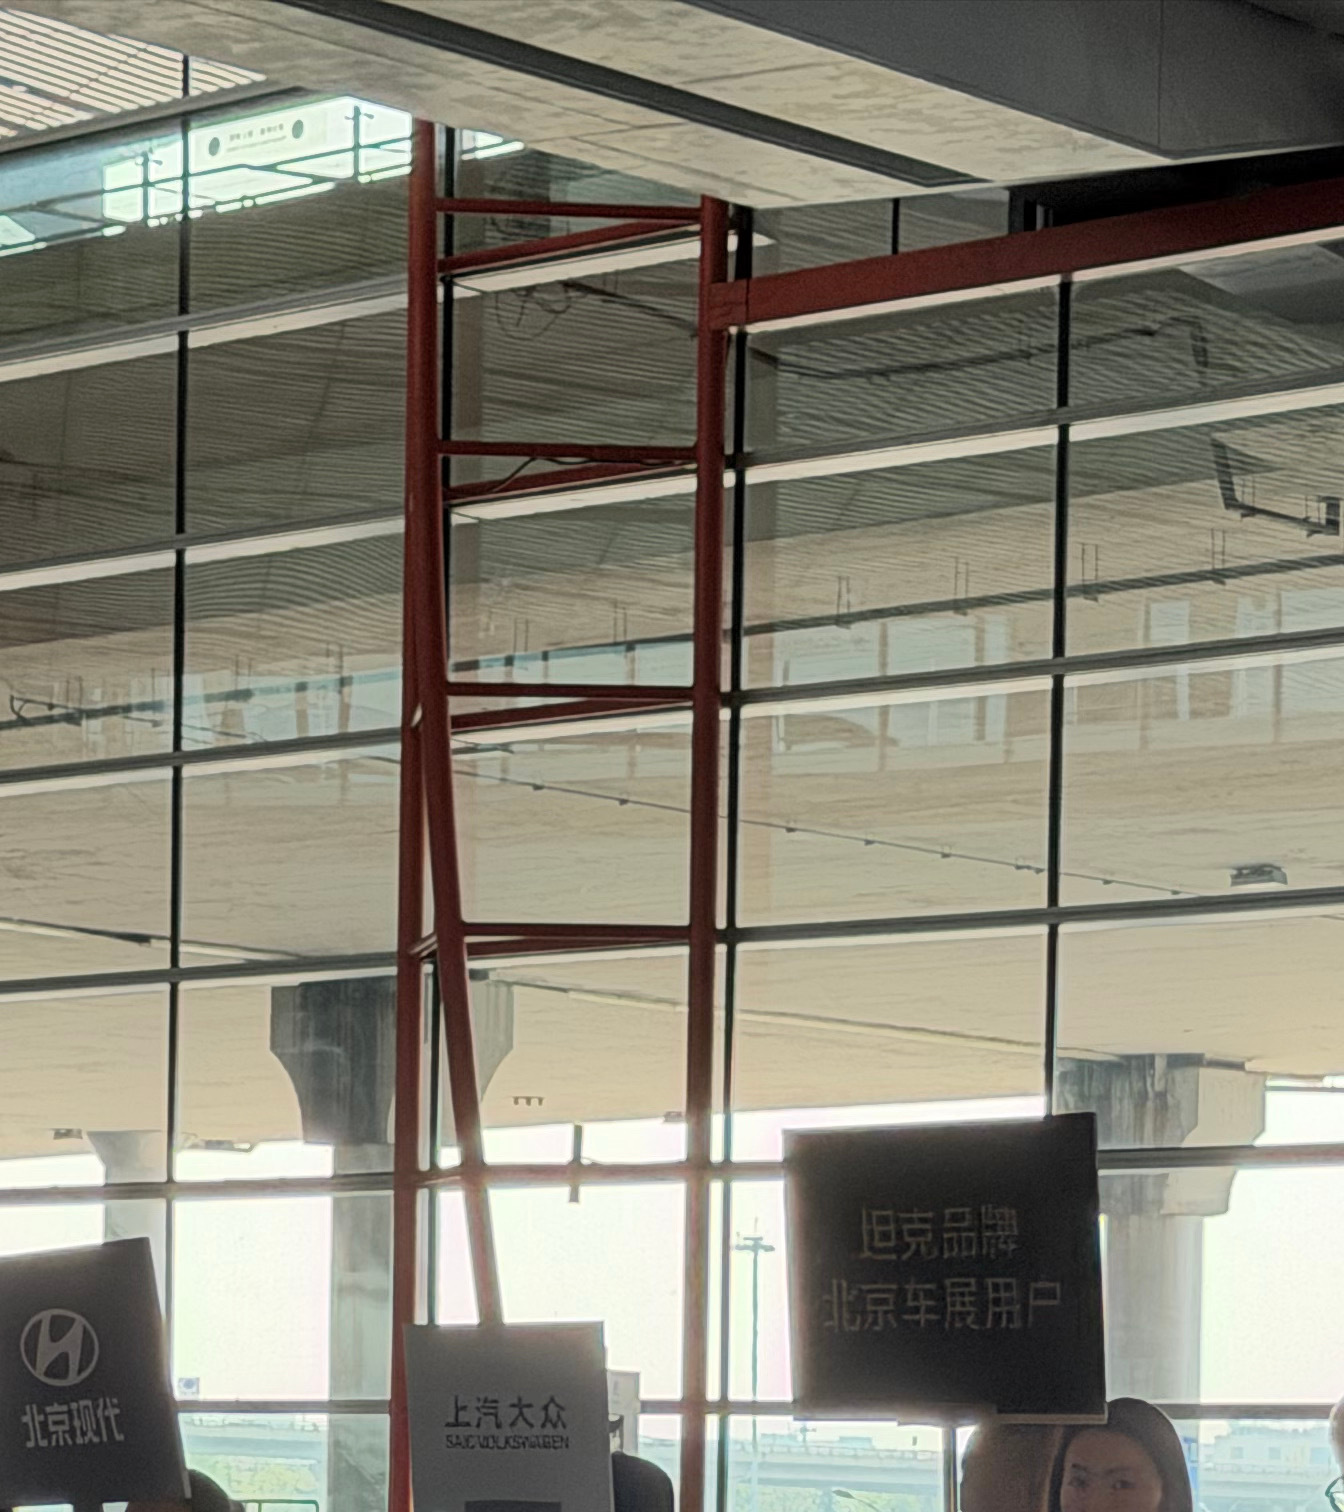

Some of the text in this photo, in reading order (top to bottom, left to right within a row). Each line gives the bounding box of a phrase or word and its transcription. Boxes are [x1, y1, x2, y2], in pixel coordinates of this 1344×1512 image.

[859, 1204, 1019, 1260] 坦克品牌
[823, 1278, 1062, 1332] 北京车展用户
[20, 1397, 125, 1449] 北京现代
[444, 1395, 567, 1430] 上汽大众
